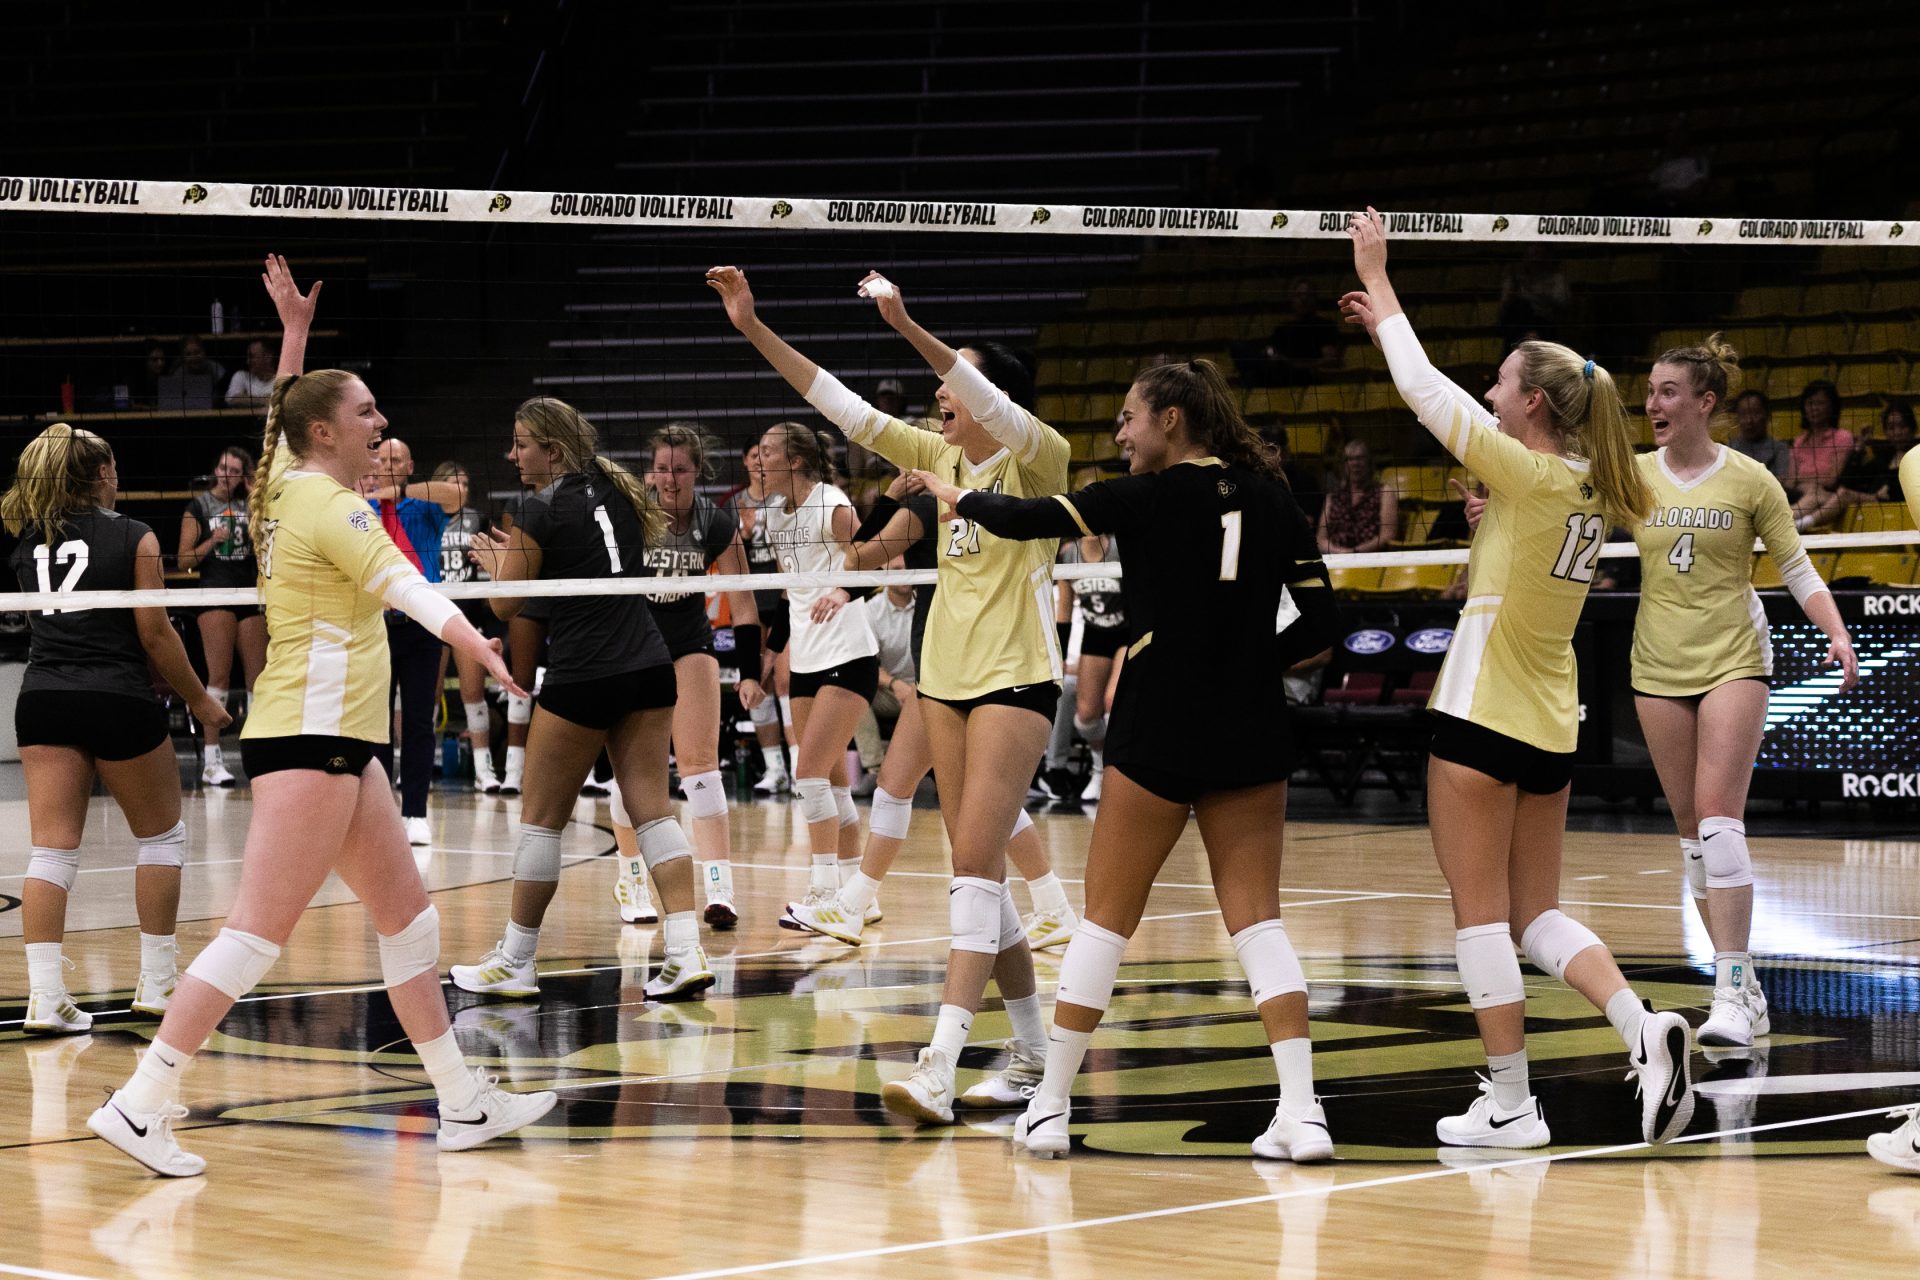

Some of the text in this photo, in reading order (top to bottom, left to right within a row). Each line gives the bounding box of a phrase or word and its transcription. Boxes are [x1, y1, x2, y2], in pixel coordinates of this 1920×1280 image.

[29, 178, 139, 205] VOLLEYBALL
[250, 185, 449, 213] COLORADO VOLLEYBALL
[550, 194, 734, 220] COLORADO VOLLEYBALL
[827, 201, 997, 226] COLORADO VOLLEYBALL
[1082, 207, 1239, 230] COLORADO VOLLEYBALL
[1389, 213, 1463, 233] VOLLEYBALL
[1537, 216, 1671, 237] COLORADO VOLLEYBALL
[1739, 220, 1864, 239] COLORADO VOLLEYBALL
[1645, 506, 1733, 530] OLORADO
[593, 505, 623, 574] 1
[947, 518, 980, 557] 21
[1219, 510, 1242, 581] 1
[1550, 512, 1604, 584] 12
[441, 550, 463, 570] 18
[642, 549, 705, 570] WESTERN
[1668, 533, 1695, 573] 4
[33, 539, 94, 616] 12
